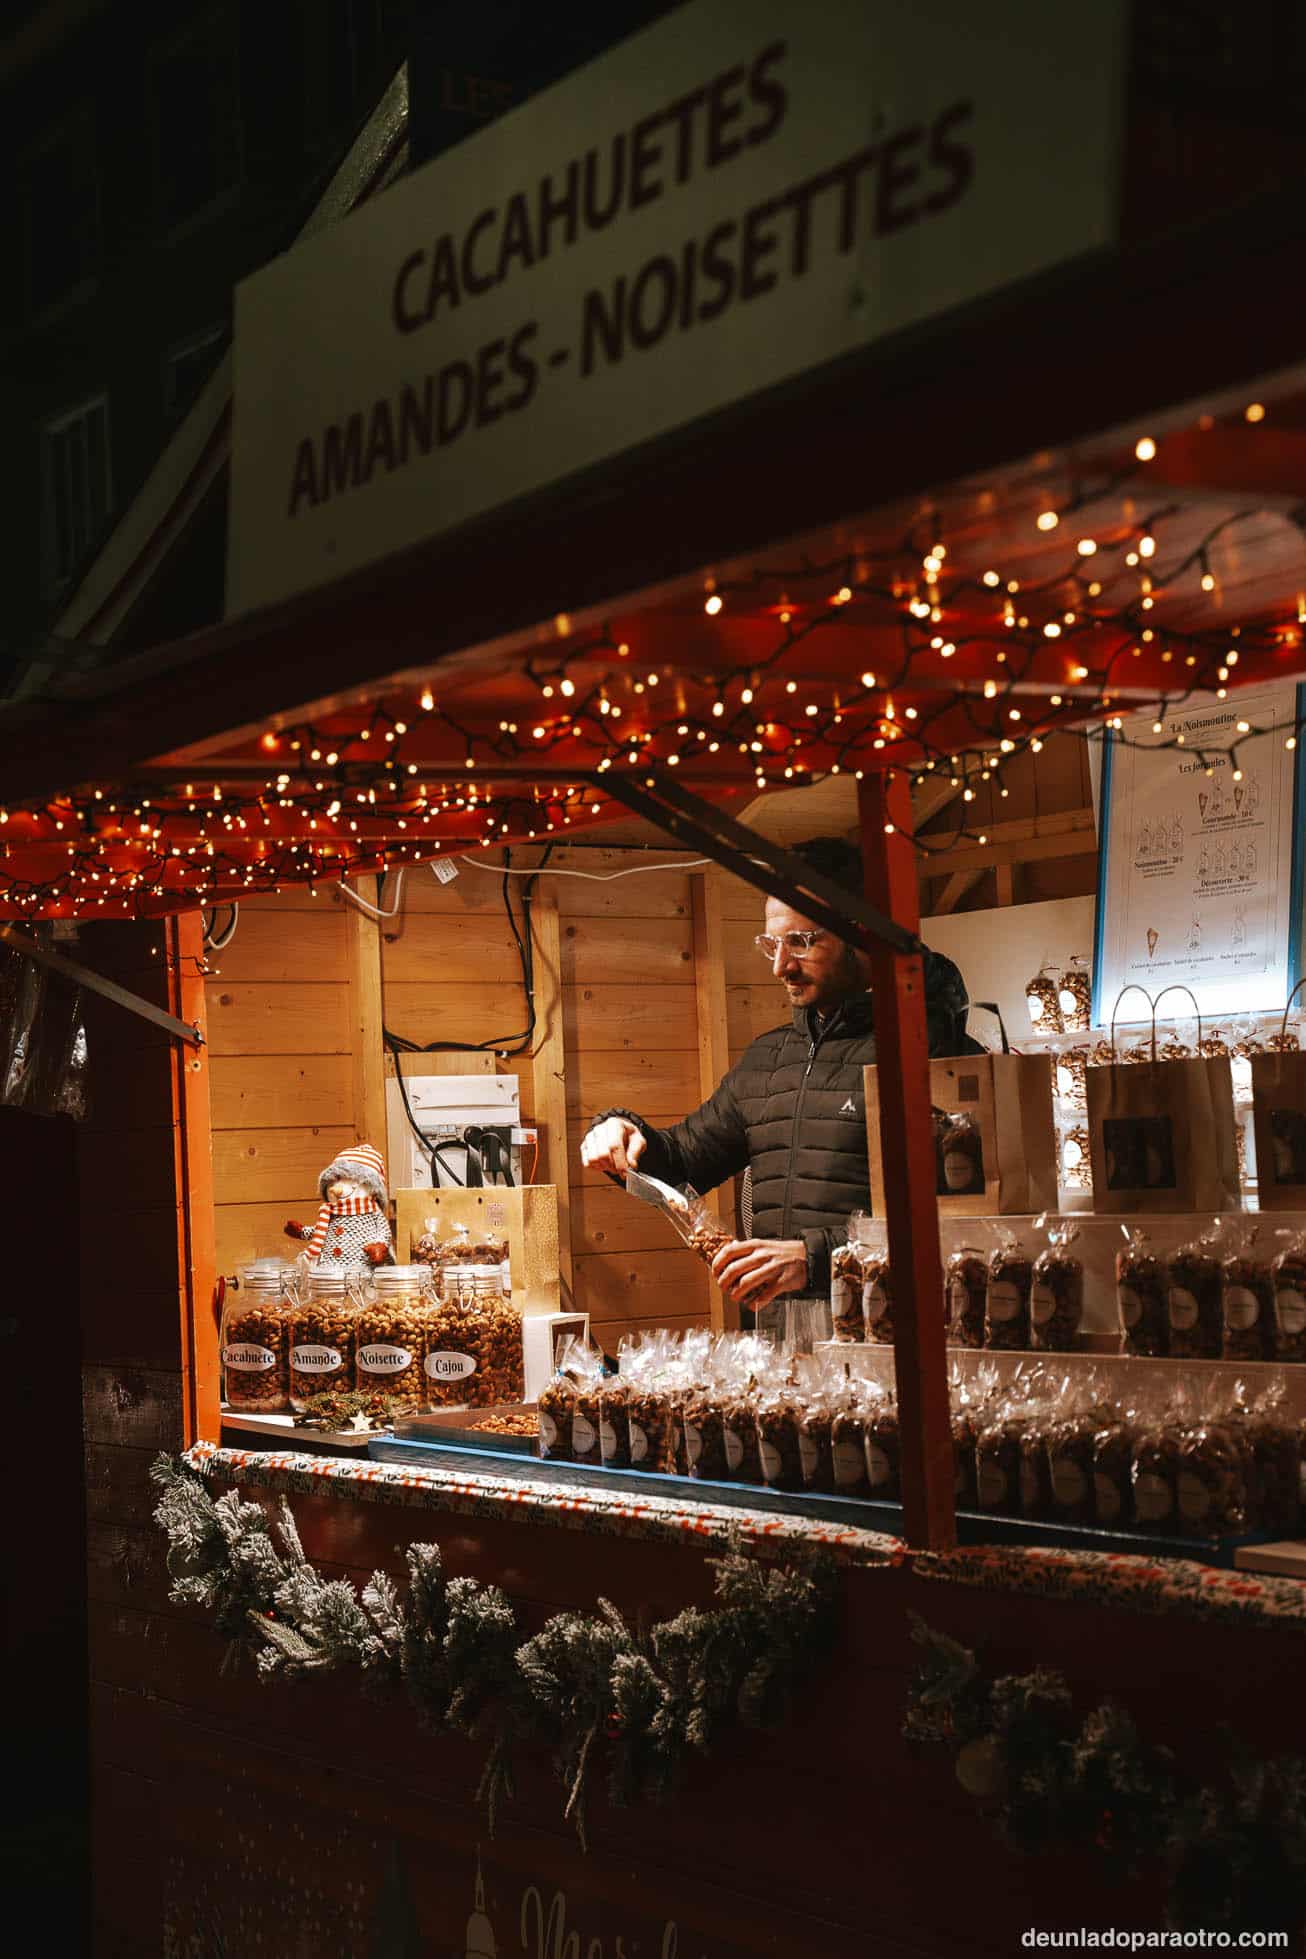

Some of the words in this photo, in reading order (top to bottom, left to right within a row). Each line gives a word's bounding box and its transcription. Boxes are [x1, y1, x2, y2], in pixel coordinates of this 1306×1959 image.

[391, 41, 789, 334] CACAHUETES
[288, 322, 540, 516] AMANDES
[549, 348, 570, 370] -
[580, 101, 975, 378] NOISETTES
[293, 1351, 337, 1366] Amande
[360, 1351, 404, 1366] Noisette
[435, 1359, 464, 1375] Cajou
